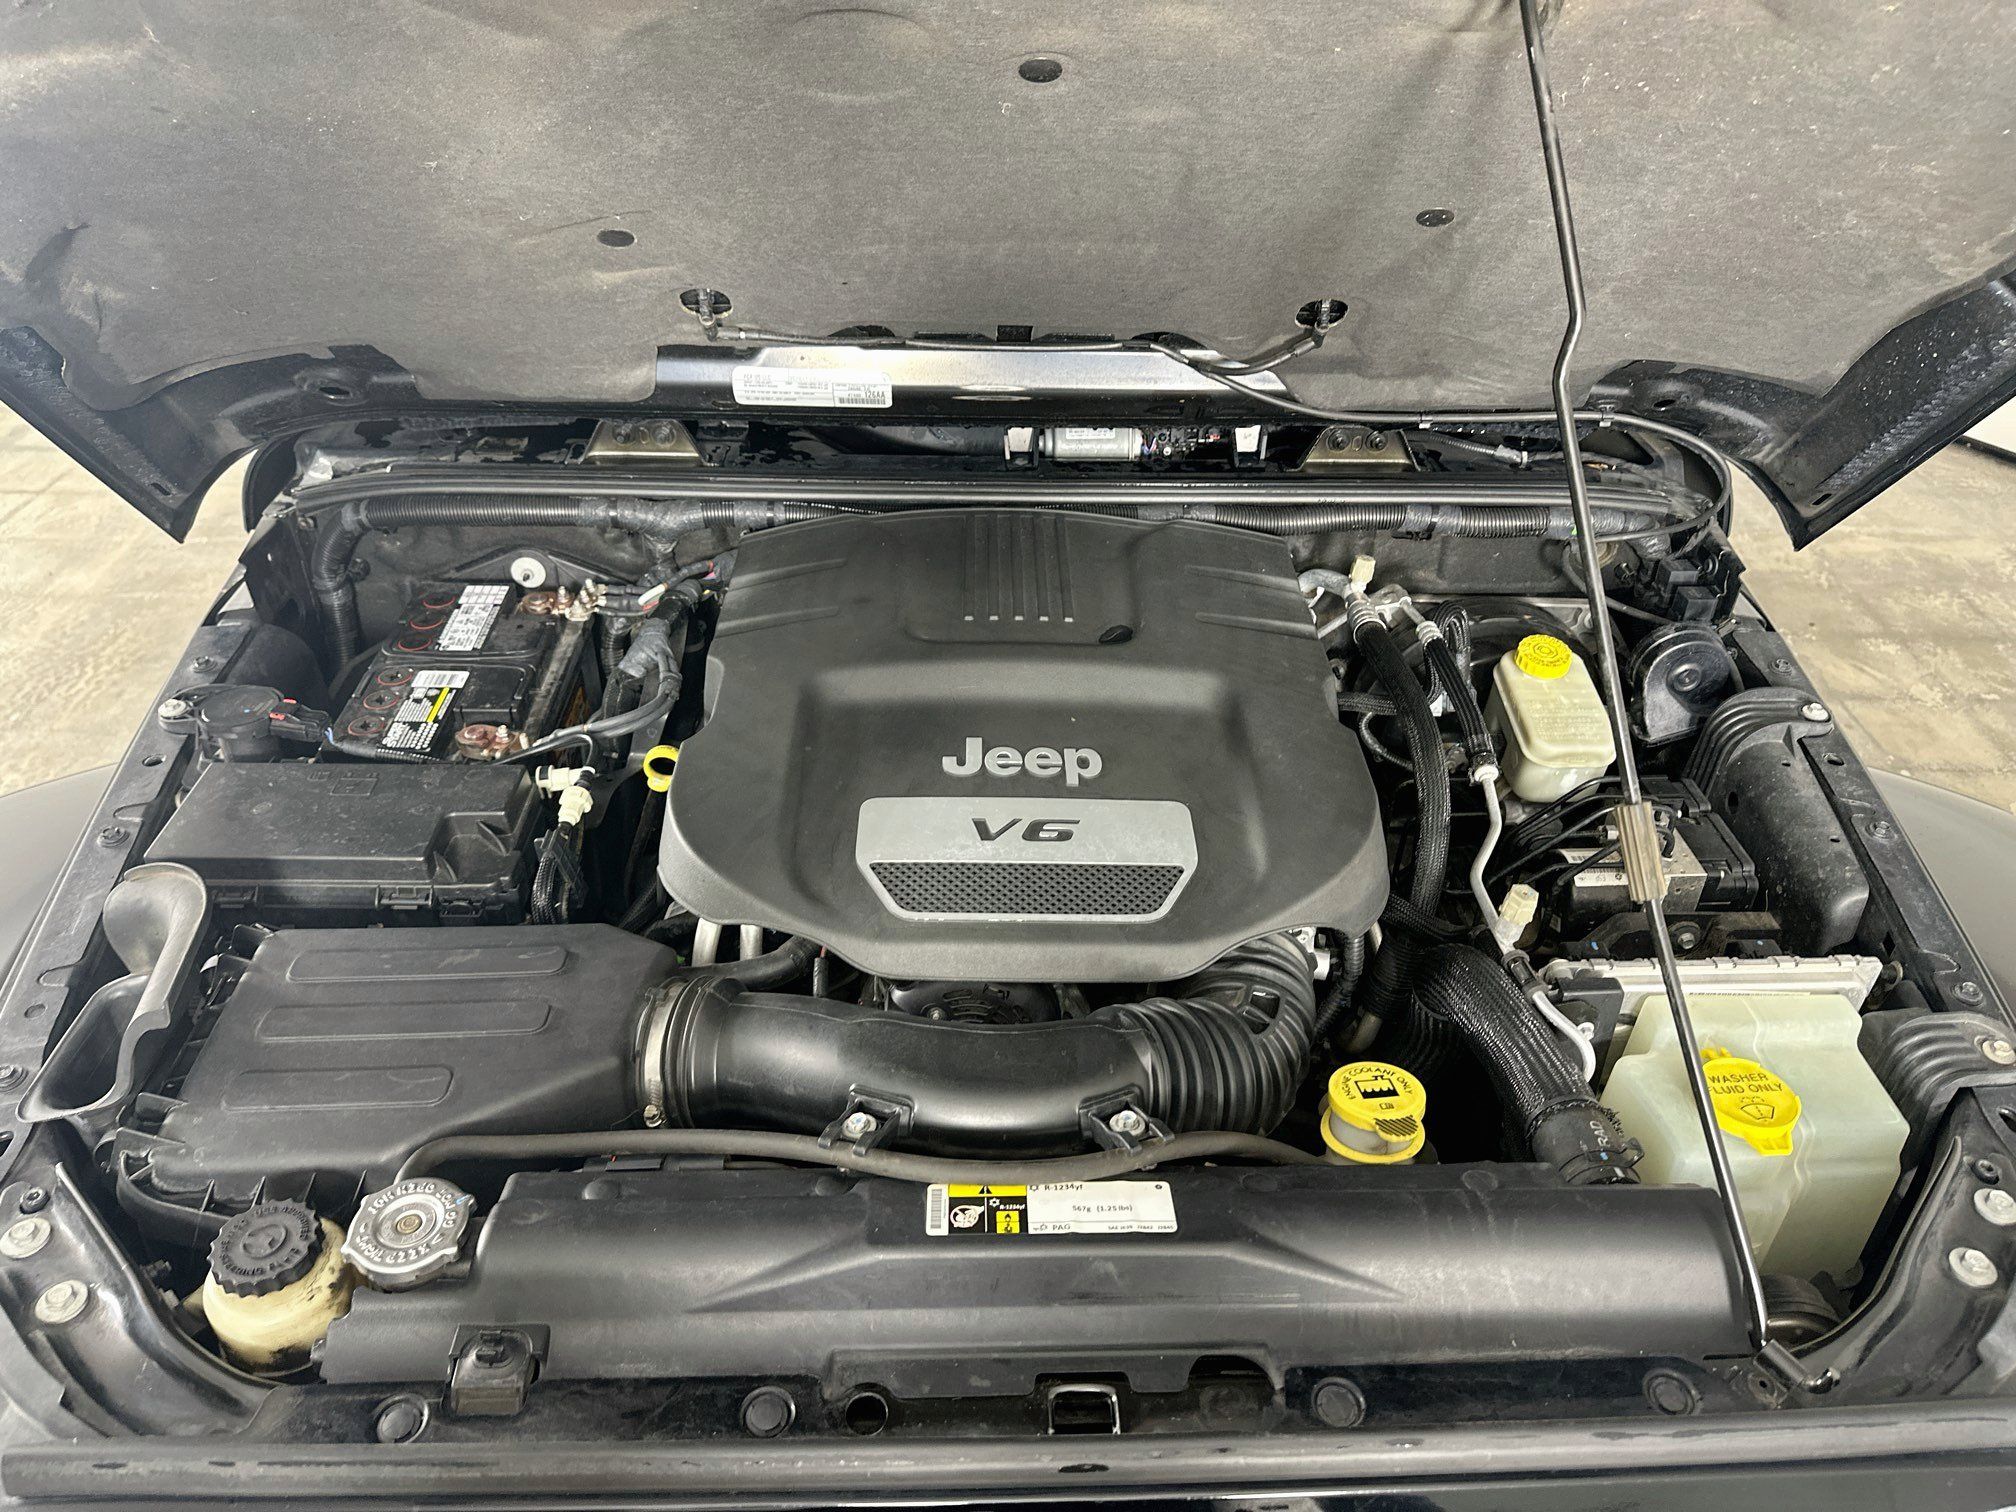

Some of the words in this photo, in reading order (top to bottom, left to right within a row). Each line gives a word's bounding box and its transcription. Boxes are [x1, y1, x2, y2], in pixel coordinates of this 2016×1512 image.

[942, 736, 1103, 787] Jeep
[972, 818, 1081, 842] V6
[1348, 1066, 1396, 1078] COOLANT
[1708, 1072, 1769, 1084] WASHER
[1342, 1074, 1356, 1100] ENGINE
[1396, 1076, 1414, 1095] ONLY
[1746, 1083, 1784, 1093] ONLY
[1044, 1184, 1083, 1192] R-1234yf
[1072, 1204, 1091, 1213] 567g
